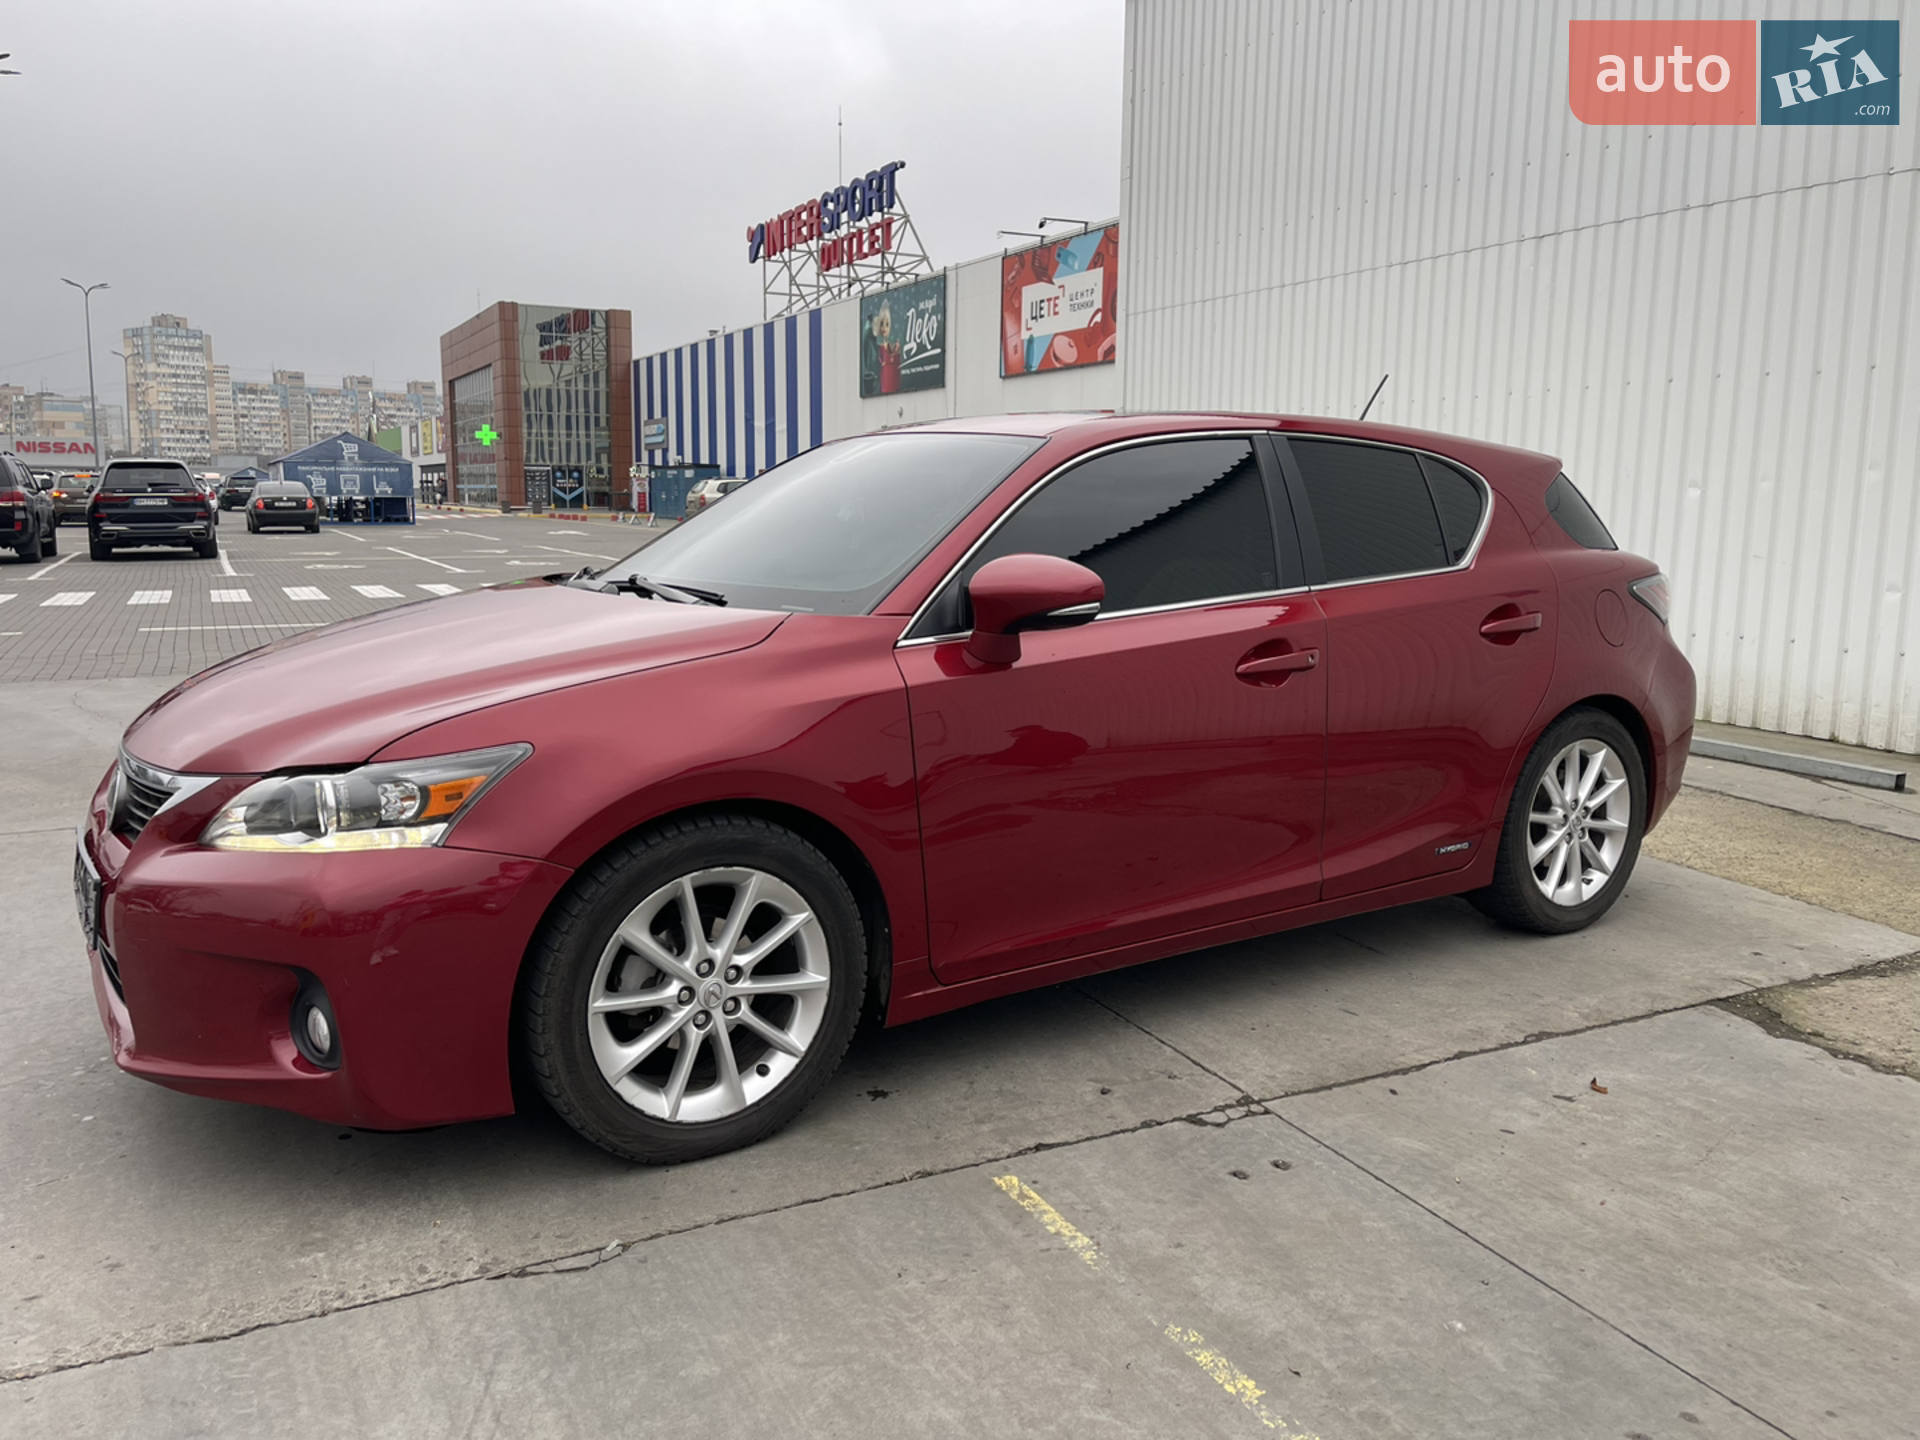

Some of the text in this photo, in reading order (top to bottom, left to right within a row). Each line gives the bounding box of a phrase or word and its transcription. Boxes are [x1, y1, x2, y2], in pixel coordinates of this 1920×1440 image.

[763, 160, 900, 260] INTERSPORT
[819, 217, 895, 273] OUTLET
[1069, 287, 1095, 302] ЦЕНТР
[1030, 295, 1061, 324] ЦЕТЕ
[15, 440, 97, 454] NISSAN
